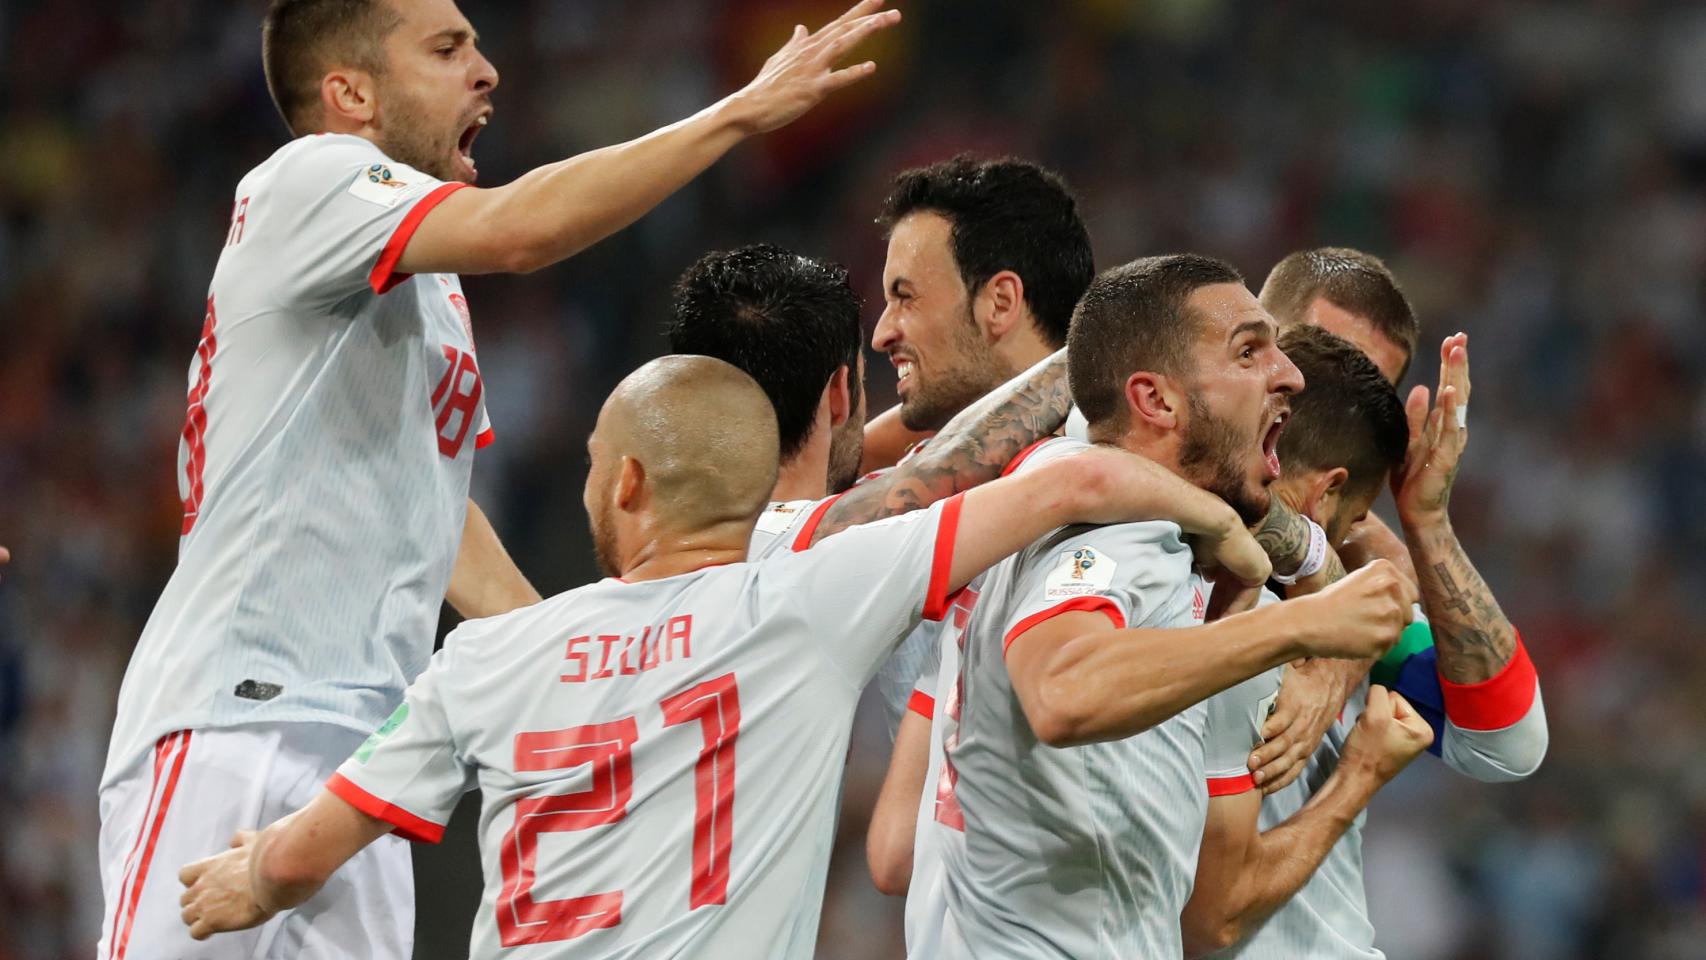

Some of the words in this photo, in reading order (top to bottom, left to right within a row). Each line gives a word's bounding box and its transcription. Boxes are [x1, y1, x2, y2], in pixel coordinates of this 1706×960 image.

[431, 344, 483, 460] 18
[560, 614, 692, 682] SILVA
[496, 671, 741, 948] 21
